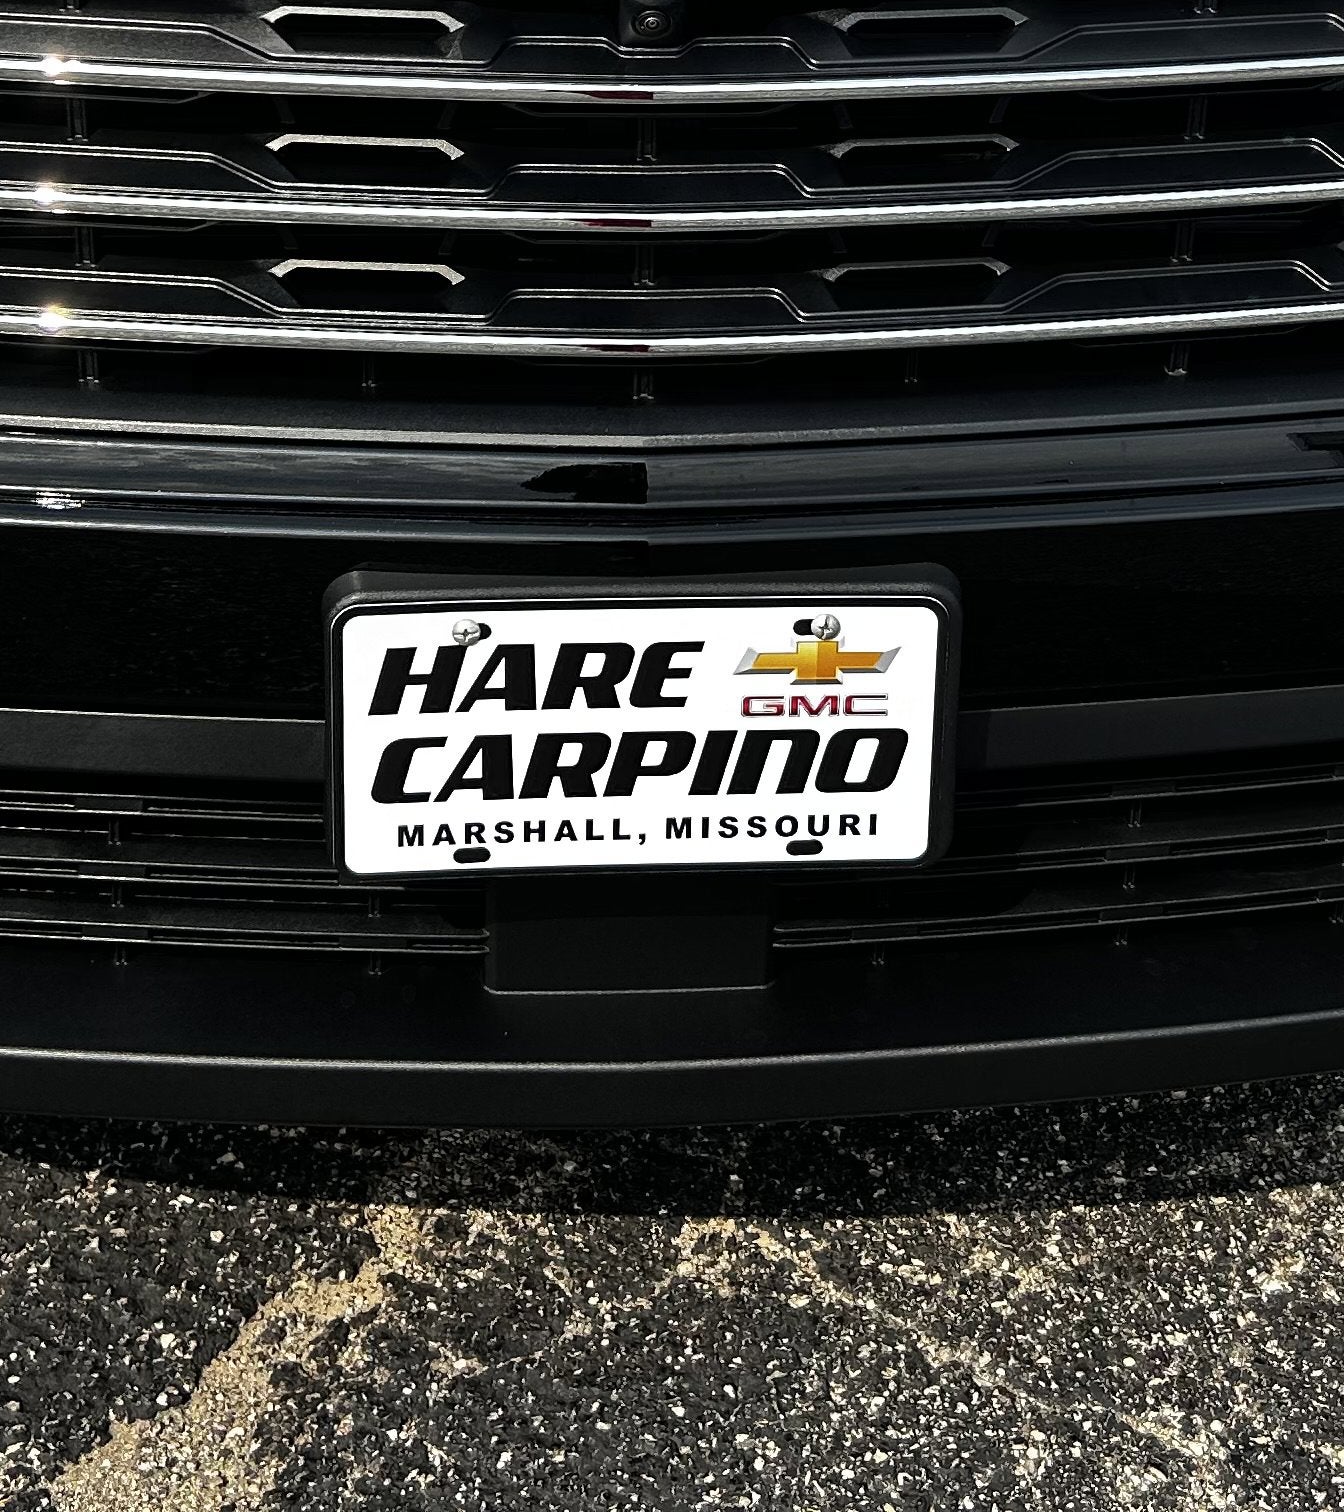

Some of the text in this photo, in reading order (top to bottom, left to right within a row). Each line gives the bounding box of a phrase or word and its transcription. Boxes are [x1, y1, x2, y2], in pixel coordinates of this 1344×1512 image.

[368, 640, 705, 716] HARE
[740, 692, 890, 718] GMC
[370, 727, 909, 804] CARPINO
[397, 813, 878, 847] MARSHALL, MISSOURI
